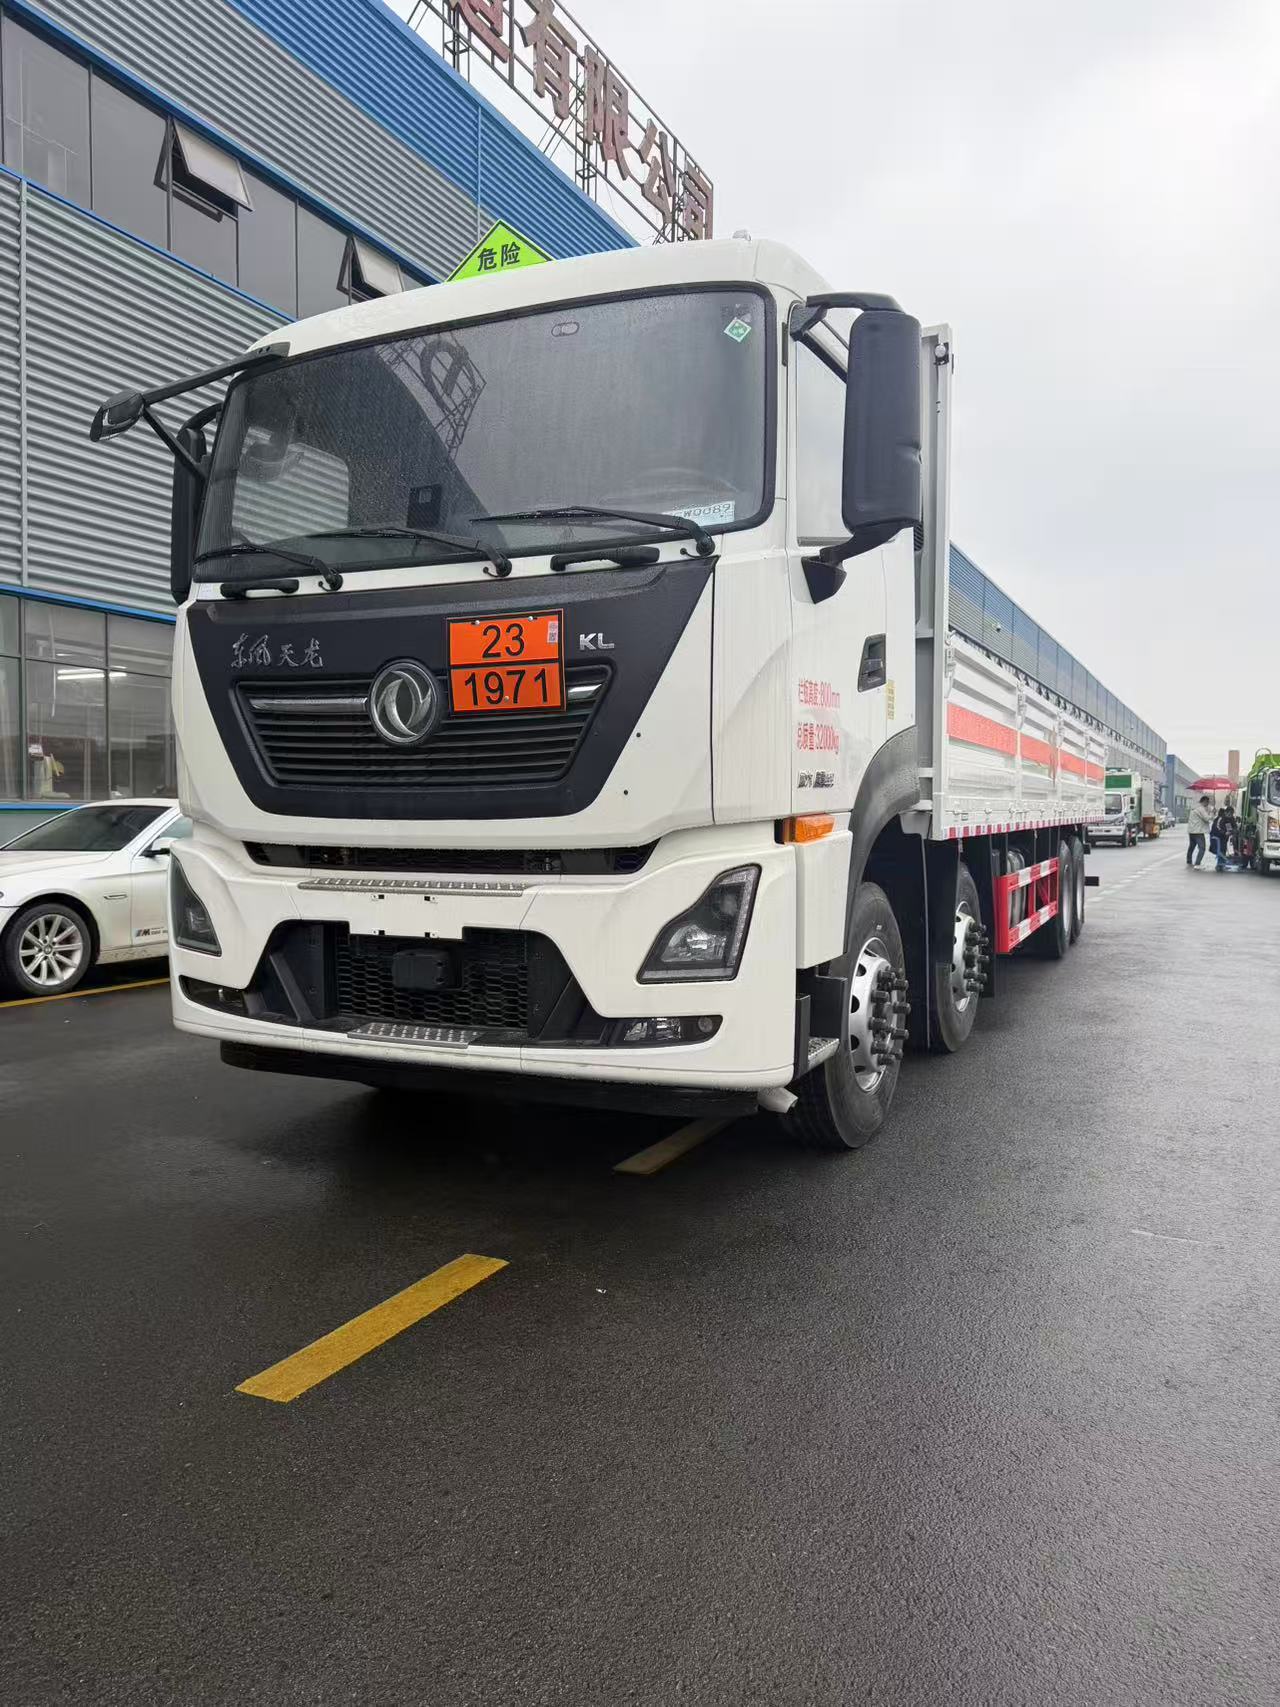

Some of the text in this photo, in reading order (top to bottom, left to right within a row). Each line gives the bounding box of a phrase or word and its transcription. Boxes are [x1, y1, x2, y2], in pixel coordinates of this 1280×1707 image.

[477, 243, 521, 272] 危险
[482, 623, 525, 659] 23
[579, 632, 615, 650] KL
[464, 667, 550, 708] 1971
